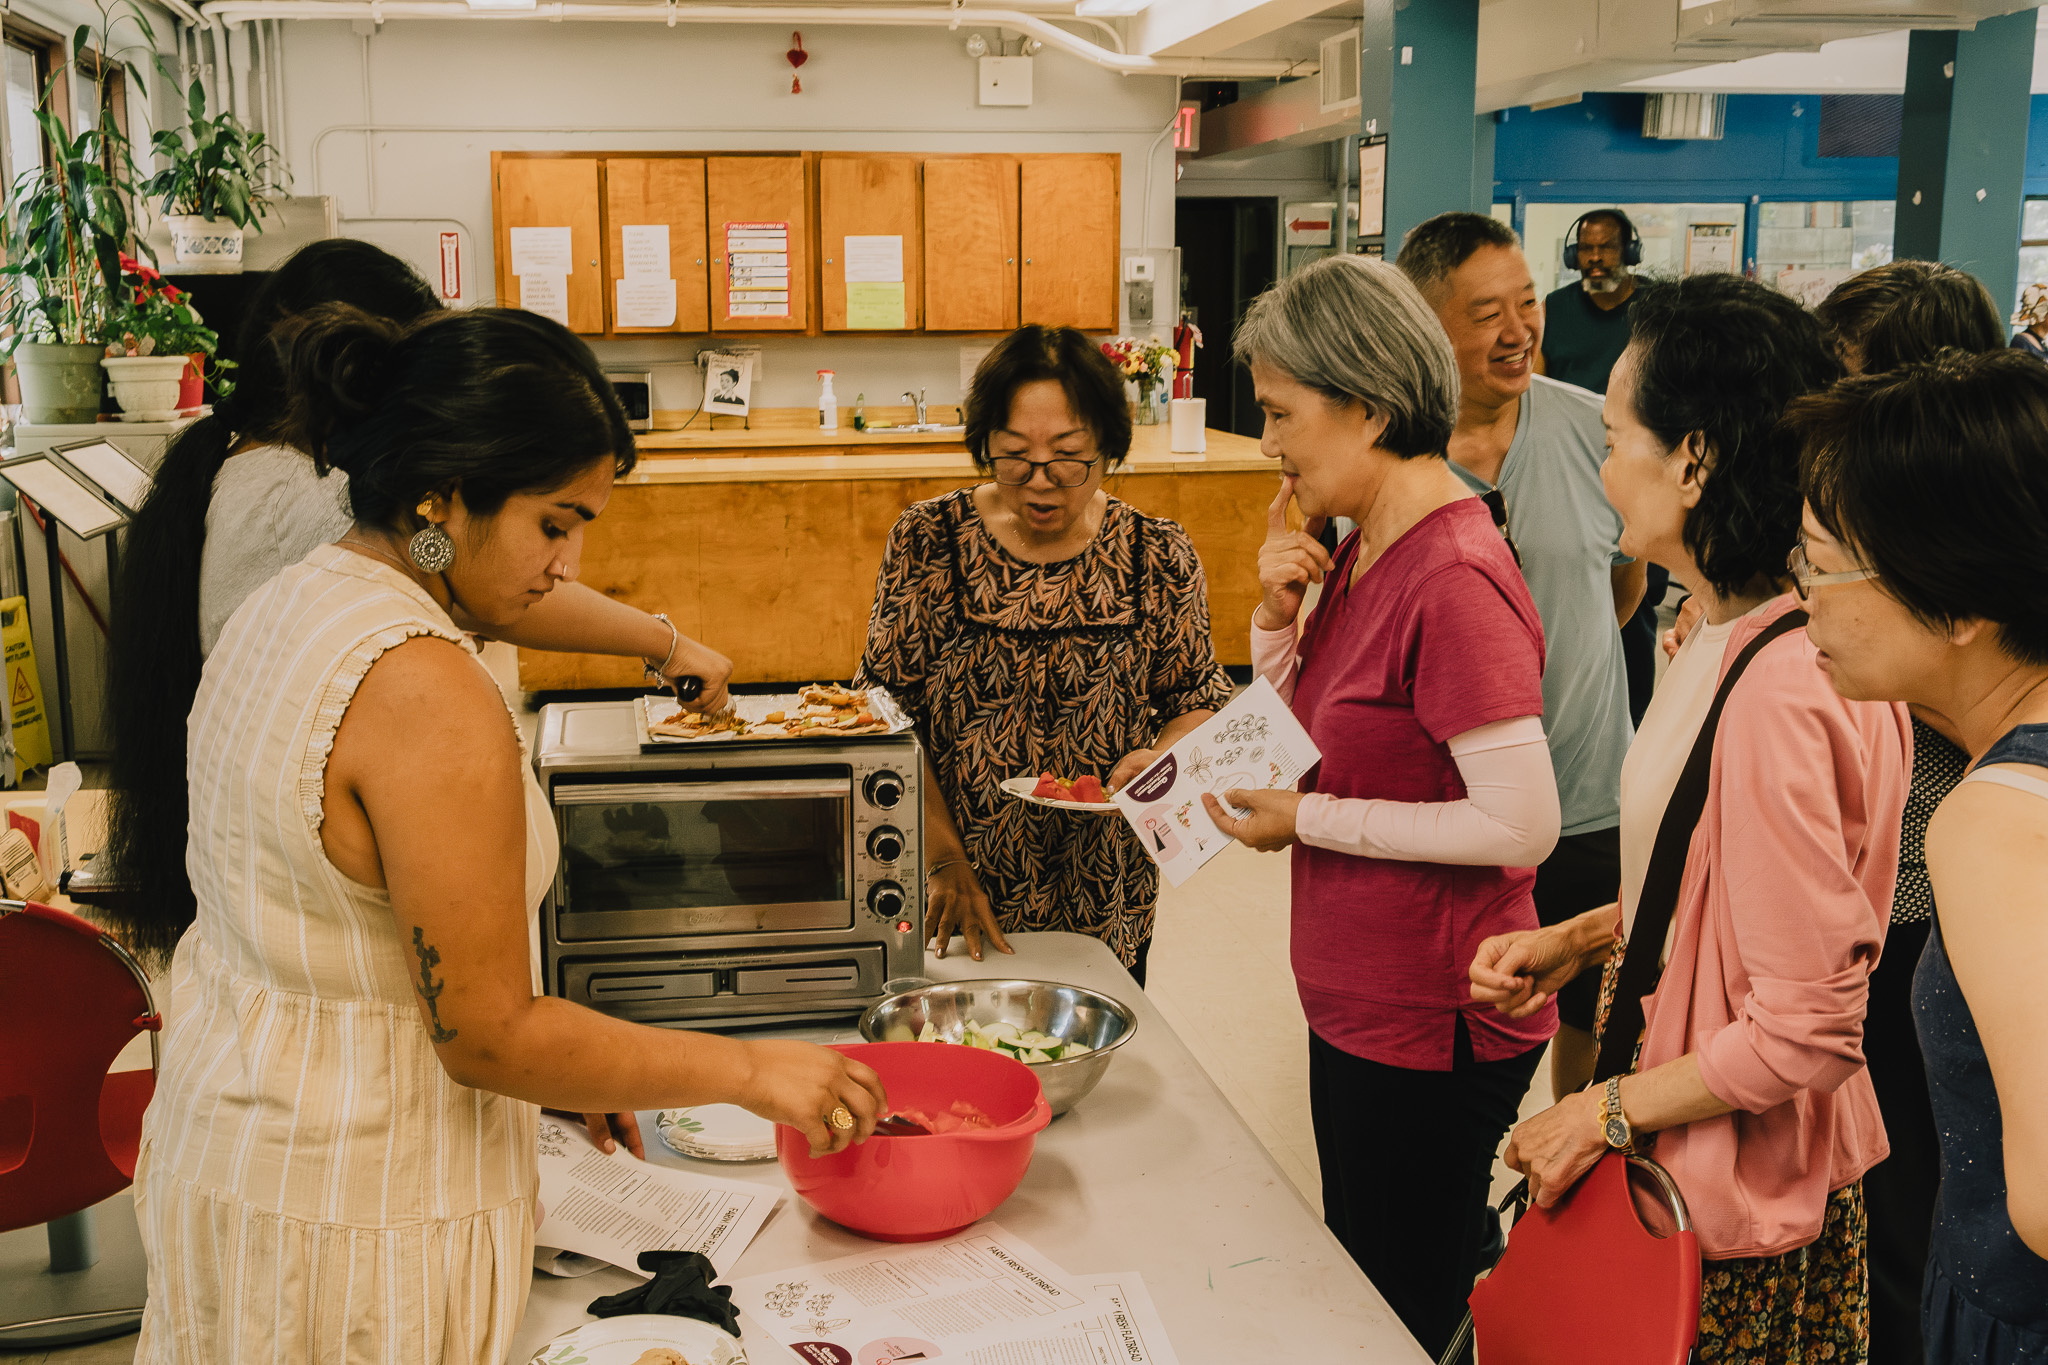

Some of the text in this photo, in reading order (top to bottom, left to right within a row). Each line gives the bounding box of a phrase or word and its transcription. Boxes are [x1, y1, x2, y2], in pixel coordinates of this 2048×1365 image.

[987, 1246, 1061, 1297] FARM FRESH FLATBREAD
[1114, 1314, 1131, 1330] FRESH
[1120, 1330, 1143, 1362] FLATBREAD
